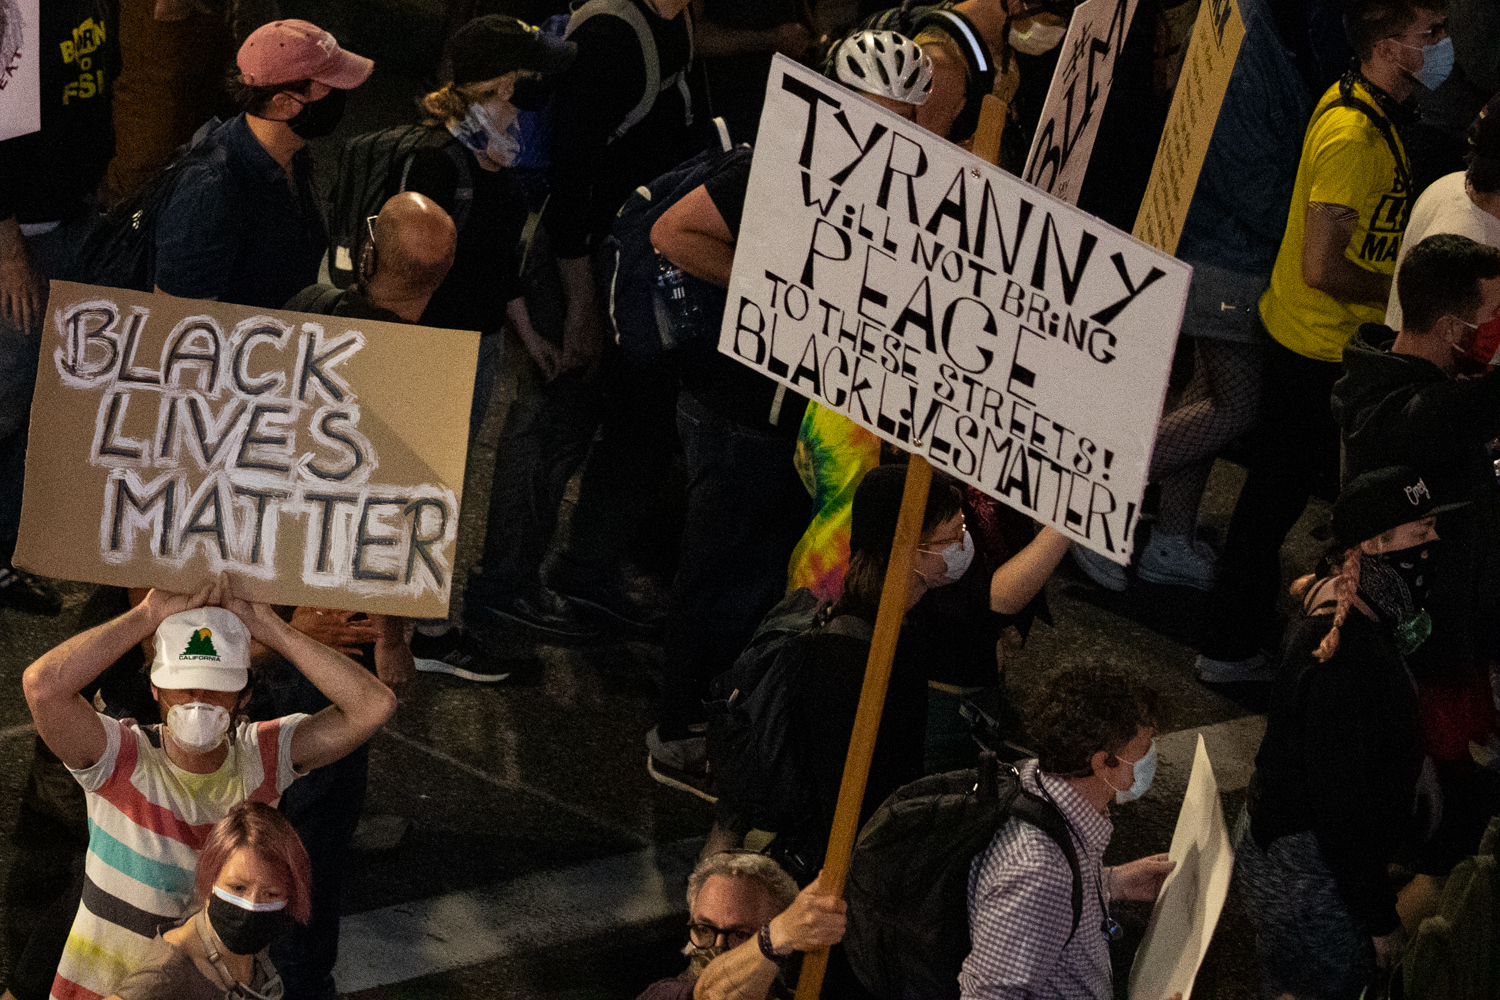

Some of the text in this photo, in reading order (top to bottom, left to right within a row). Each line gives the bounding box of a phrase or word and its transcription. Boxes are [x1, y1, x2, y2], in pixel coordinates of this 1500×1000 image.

[782, 73, 1166, 326] TYRANNY
[800, 218, 1046, 407] PEACE
[911, 232, 996, 297] NOT
[55, 302, 365, 403] BLACK
[764, 269, 1114, 481] TO THESE STREETS!
[92, 389, 379, 485] LIVES
[102, 470, 458, 600] MATTER
[178, 654, 221, 662] CALIFORNIA
